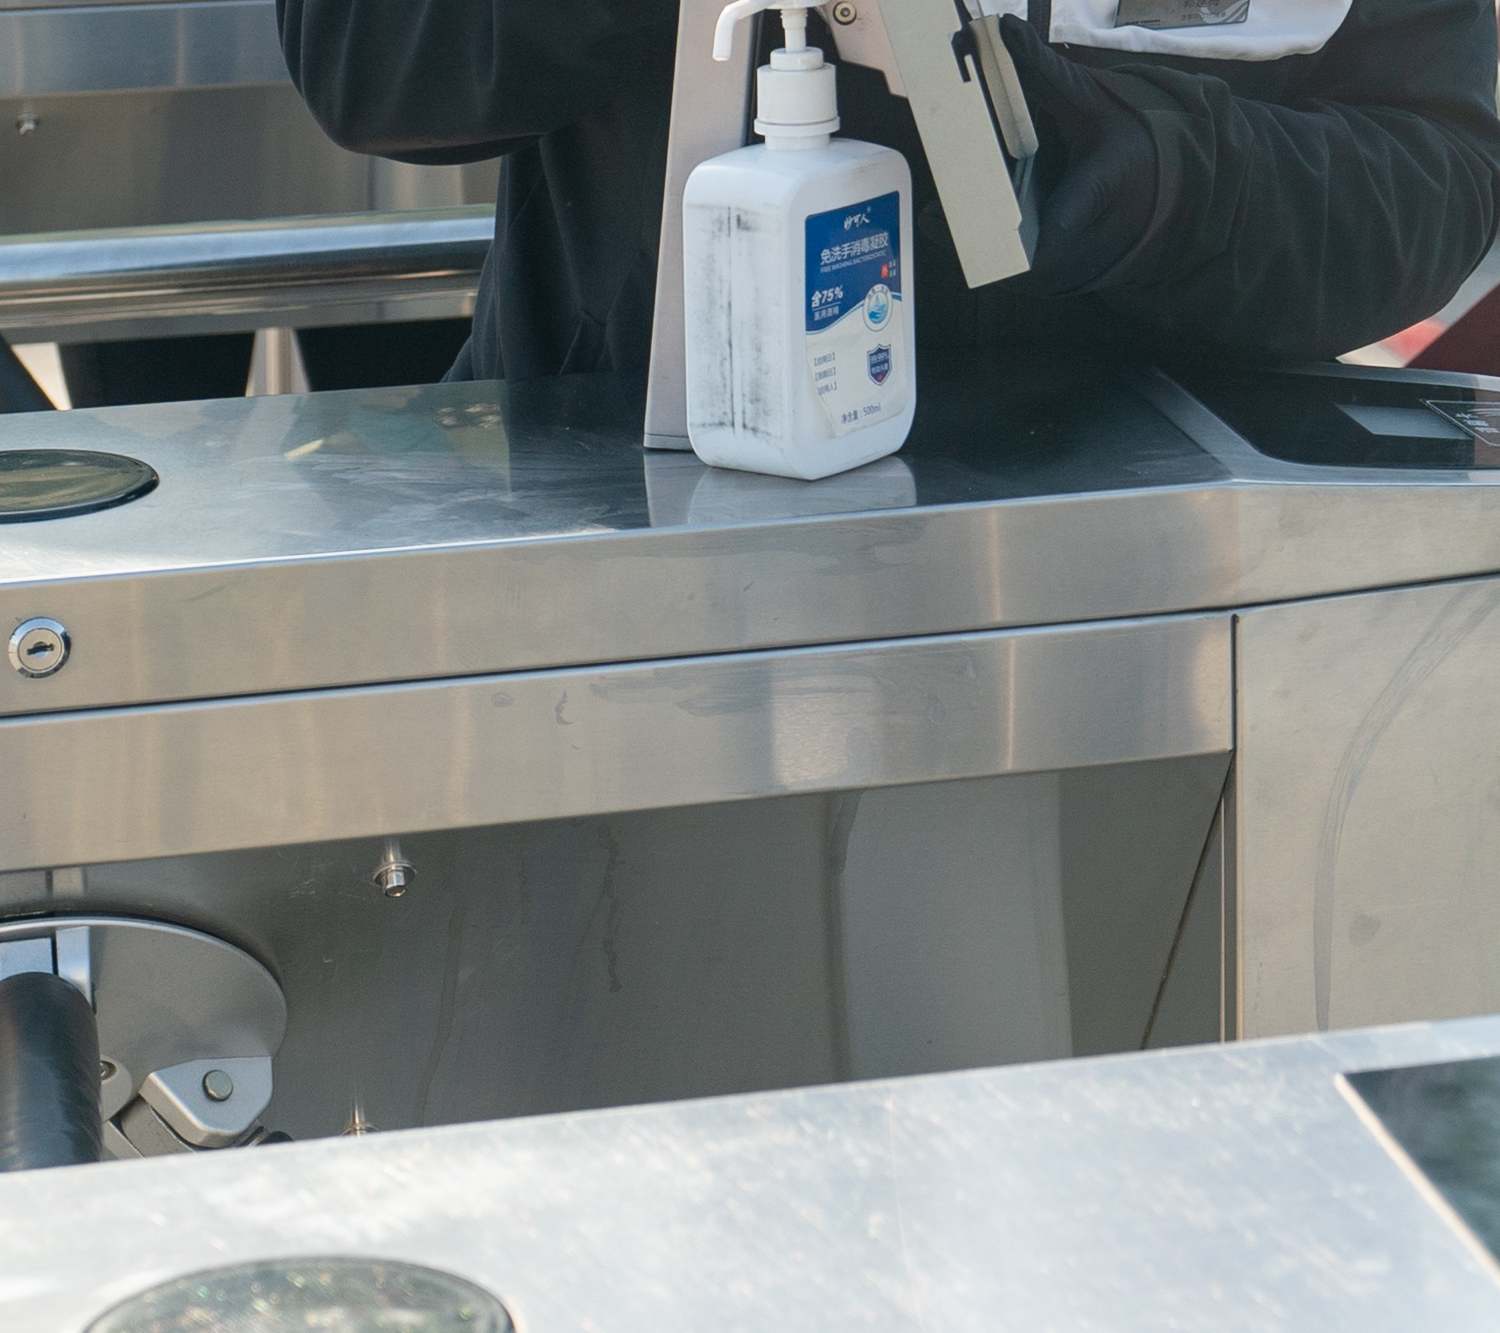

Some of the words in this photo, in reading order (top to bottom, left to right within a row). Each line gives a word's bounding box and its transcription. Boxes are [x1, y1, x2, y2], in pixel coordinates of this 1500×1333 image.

[820, 231, 889, 266] 免洗手消毒凝胶
[811, 284, 844, 308] 含75%
